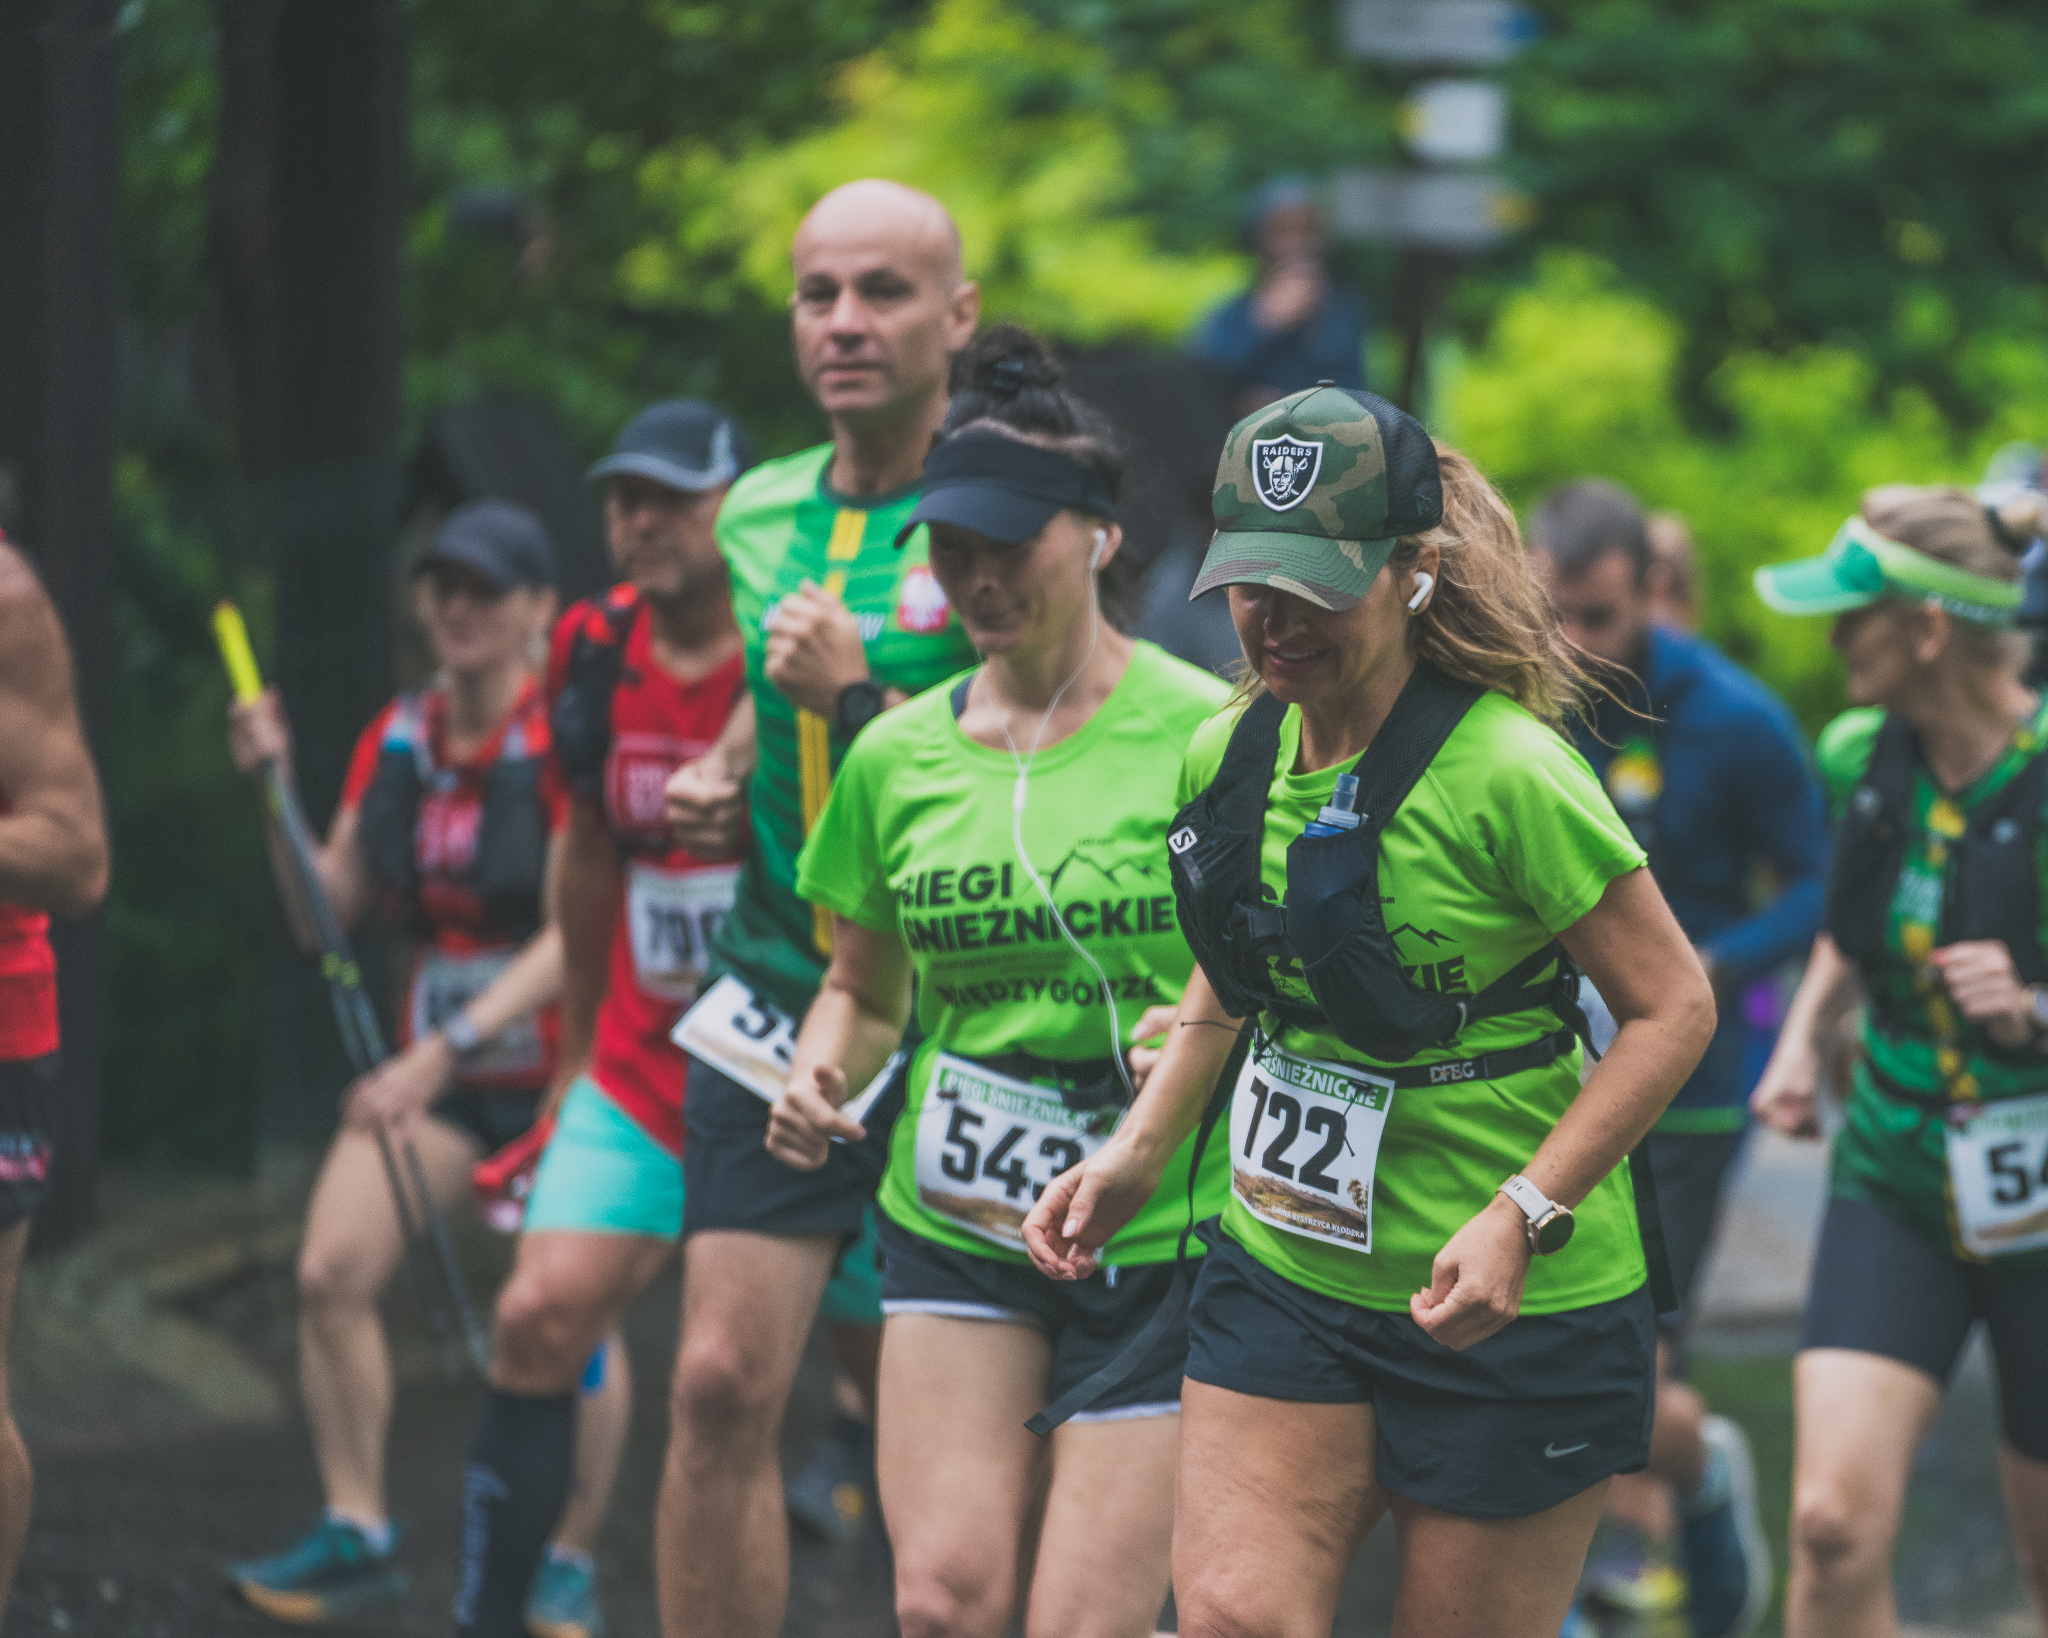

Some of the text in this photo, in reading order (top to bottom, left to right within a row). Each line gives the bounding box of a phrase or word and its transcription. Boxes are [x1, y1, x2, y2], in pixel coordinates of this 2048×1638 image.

[1262, 446, 1313, 457] RAIDERS
[941, 1105, 1084, 1203] 543
[1243, 1075, 1343, 1196] 722
[1332, 1223, 1365, 1240] KŁODZKA
